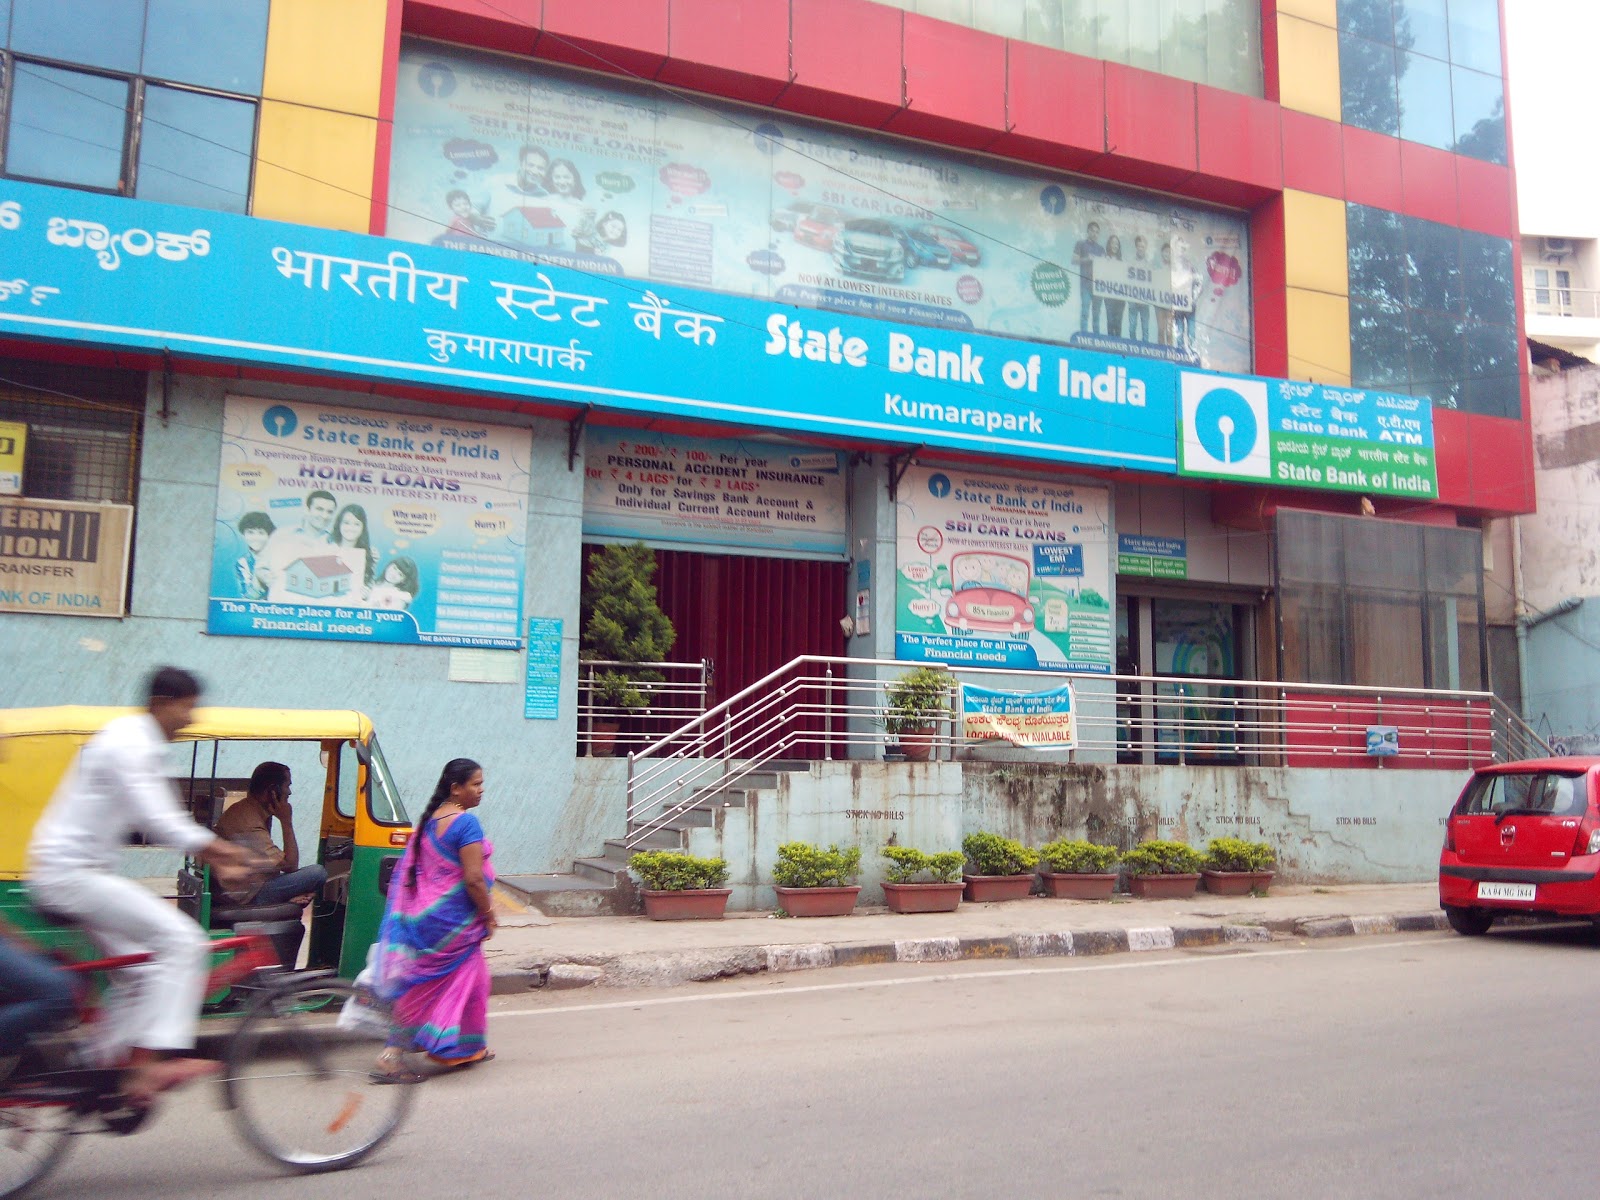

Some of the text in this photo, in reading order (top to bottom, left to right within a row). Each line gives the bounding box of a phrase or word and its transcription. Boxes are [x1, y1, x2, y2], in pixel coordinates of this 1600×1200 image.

[468, 114, 508, 129] SBI
[516, 122, 585, 142] HOME
[593, 136, 668, 157] LOANS
[821, 190, 846, 205] SBI
[851, 196, 880, 211] CAR
[885, 202, 934, 221] LOANS
[1127, 266, 1153, 283] SBI
[271, 246, 725, 346] भारतीय स्टेट बैंक
[798, 272, 953, 306] NOW AT LOWEST INTEREST RATES
[1094, 279, 1189, 308] EDUCATIONAL LOANS
[422, 328, 593, 371] कुमारापार्क
[765, 313, 1146, 408] State Bank of India
[884, 393, 1043, 434] Kumarapark
[1281, 418, 1423, 445] State Bank ATM
[303, 425, 500, 461] State Bank of India
[607, 455, 825, 486] PERSONAL ACCIDENT INSURANCE
[720, 453, 739, 464] Per
[745, 457, 768, 469] year
[299, 463, 461, 492] HOME LOANS
[586, 467, 602, 479] for
[625, 471, 633, 481] 4
[677, 475, 693, 487] for
[1277, 461, 1431, 493] State Bank of India
[278, 477, 308, 489] NOW
[311, 481, 327, 491] AT
[328, 483, 379, 495] LOWEST
[381, 486, 438, 500] INTEREST
[441, 492, 479, 505] RATES
[618, 483, 814, 510] Only for Savings Bank Account &
[954, 488, 1084, 514] State Bank of India
[615, 496, 671, 511] Individual
[678, 502, 720, 516] Current
[726, 506, 770, 519] Account
[776, 509, 817, 523] Holders
[961, 511, 1051, 529] Your Dream Car is here
[944, 519, 973, 533] SBI
[977, 523, 1011, 538] CAR
[1015, 526, 1067, 542] LOANS
[1039, 546, 1074, 556] LOWEST
[1049, 554, 1067, 564] EMI
[28, 592, 52, 605] OF
[57, 593, 102, 608] INDIA
[220, 601, 404, 623] The Perfect place for all your
[251, 617, 373, 636] Financial needs
[419, 634, 517, 647] THE BANKER TO EVERY INDIAN
[901, 634, 1028, 652] The Perfect place for all your
[924, 648, 1007, 662] Financial needs
[982, 704, 1002, 713] State
[1005, 704, 1024, 713] Bank
[1026, 705, 1035, 713] of
[1031, 730, 1071, 742] AVAILABLE
[846, 809, 868, 819] STICK
[883, 810, 904, 821] BILLS
[1215, 816, 1234, 824] STICK
[1244, 816, 1261, 825] BILLS
[1336, 817, 1377, 825] STICK NO BILLS
[1481, 886, 1532, 897] KA 04 MG 1844
